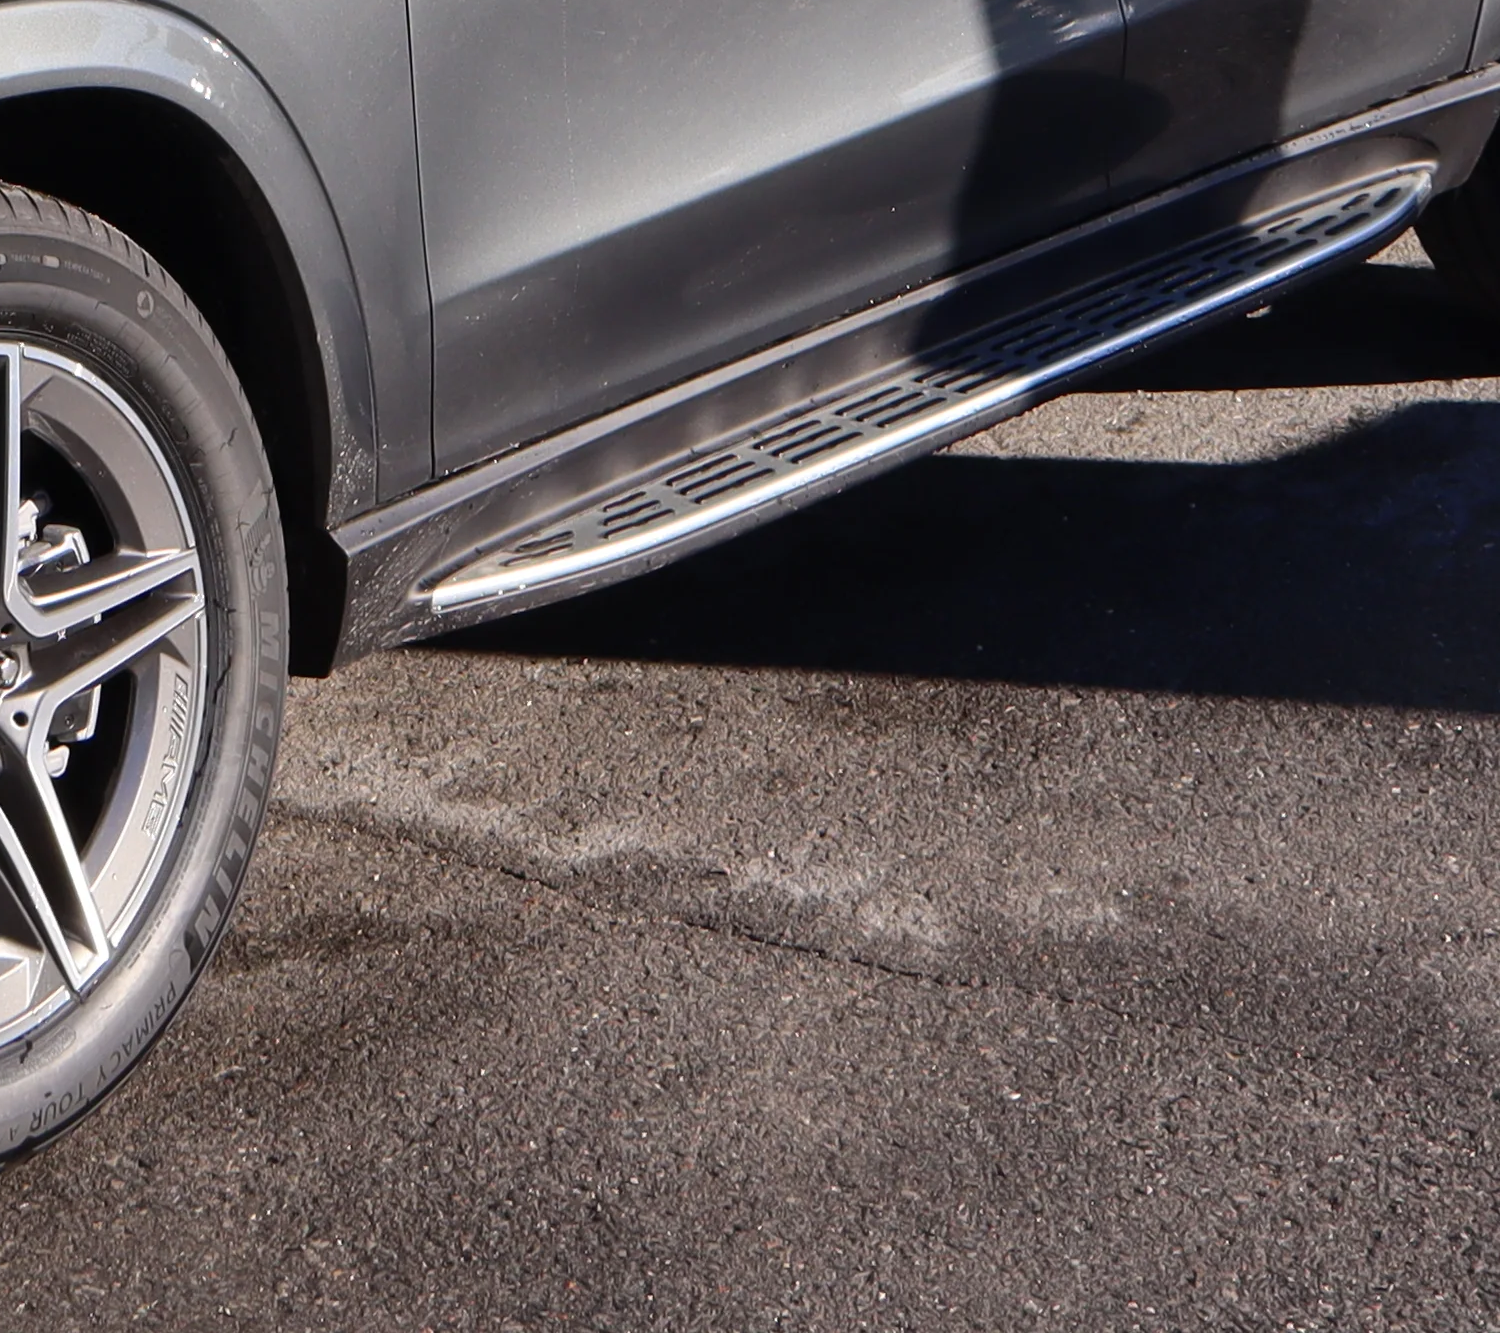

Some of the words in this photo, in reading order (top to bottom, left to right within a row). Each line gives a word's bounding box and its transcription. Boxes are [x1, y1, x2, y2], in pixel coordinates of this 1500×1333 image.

[192, 612, 283, 950] MICHELIN
[95, 980, 178, 1089] PRIMACY
[29, 1082, 89, 1133] TOUR
